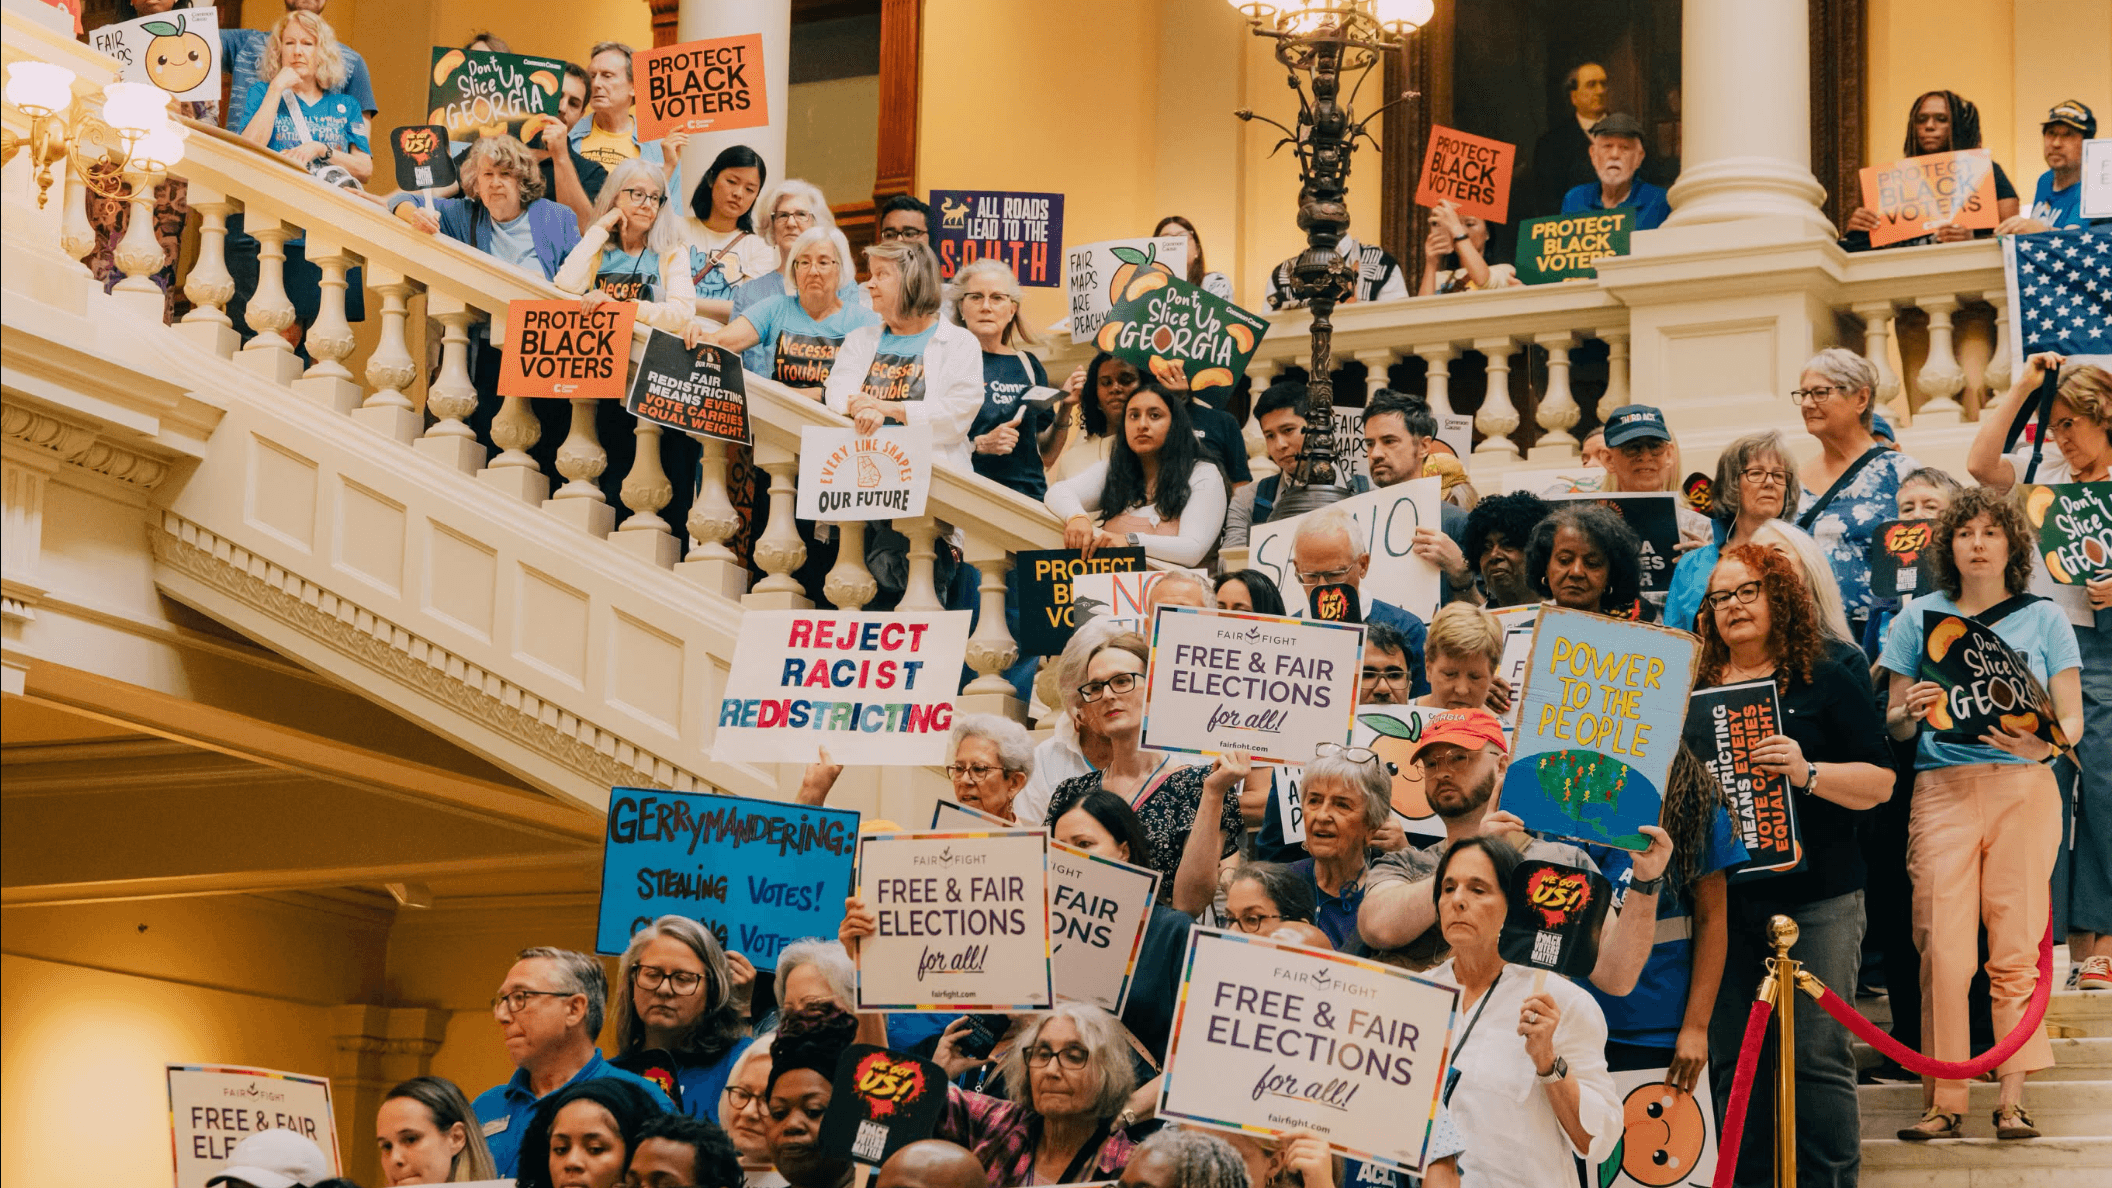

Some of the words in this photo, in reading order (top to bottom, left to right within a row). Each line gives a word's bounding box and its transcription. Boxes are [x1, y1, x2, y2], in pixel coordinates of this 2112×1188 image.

[96, 30, 125, 52] FAIR
[648, 45, 746, 77] PROTECT
[457, 75, 496, 98] Slice
[499, 64, 524, 96] Up
[649, 63, 749, 101] BLACK
[446, 84, 544, 130] GEORGIA
[651, 89, 751, 121] VOTERS
[404, 136, 433, 153] US!
[1436, 135, 1501, 165] PROTECT
[1431, 151, 1497, 188] BLACK
[1878, 159, 1973, 187] PROTECT
[1429, 172, 1495, 206] VOTERS
[1880, 174, 1979, 208] BLACK
[977, 196, 1000, 218] ALL
[1003, 197, 1049, 220] ROADS
[967, 218, 999, 240] LEAD
[1002, 219, 1020, 241] TO
[1023, 220, 1049, 242] THE
[1531, 214, 1626, 240] PROTECT
[1543, 232, 1611, 255] BLACK
[1070, 250, 1093, 273] FAIR
[1070, 270, 1098, 292] MAPS
[1073, 293, 1091, 315] ARE
[523, 310, 620, 330] PROTECT
[1148, 298, 1190, 327] Slice
[1195, 306, 1221, 342] Up
[520, 330, 617, 356] BLACK
[1119, 321, 1233, 367] GEORGIA
[520, 357, 614, 379] VOTERS
[690, 372, 721, 387] FAIR
[776, 358, 830, 383] Trouble
[647, 371, 744, 406] REDISTRICTING
[648, 383, 702, 406] MEANS
[704, 398, 742, 414] EVERY
[637, 402, 687, 426] EQUAL
[691, 418, 746, 439] WEIGHT.
[645, 393, 684, 413] VOTE
[687, 406, 743, 427] CARRIES
[1620, 413, 1642, 425] THIRD
[820, 445, 849, 484] EVERY
[855, 438, 878, 453] LINE
[882, 440, 912, 482] SHAPES
[819, 490, 852, 513] OUR
[856, 489, 910, 511] FUTURE
[1890, 534, 1926, 551] US!
[2055, 514, 2103, 541] Slice
[1321, 601, 1342, 619] US!
[788, 619, 929, 652] REJECT
[1217, 630, 1244, 641] FAIR
[1262, 634, 1297, 646] FIGHT
[780, 658, 924, 690] RACIST
[1175, 643, 1242, 671] FREE
[1248, 652, 1266, 674] &
[1275, 654, 1334, 681] FAIR
[1550, 636, 1666, 689] POWER
[1964, 648, 2012, 677] Slice
[1171, 669, 1332, 708] ELECTIONS
[1559, 677, 1592, 710] TO
[1599, 684, 1643, 720] THE
[718, 698, 953, 733] REDISTRICTING
[1207, 703, 1241, 733] for
[1244, 709, 1289, 731] all!
[1538, 702, 1653, 758] PEOPLE
[1728, 709, 1749, 774] EVERY
[1743, 704, 1767, 791] CARIES
[1736, 778, 1759, 849] MEANS
[1755, 795, 1774, 849] VOTE
[1769, 785, 1789, 852] EQUAL
[913, 855, 938, 866] FAIR
[954, 854, 987, 866] FIGHT
[1052, 861, 1084, 879] IGHT
[748, 876, 825, 912] VOTES!
[878, 878, 939, 903] FREE
[946, 877, 963, 903] &
[970, 876, 1024, 902] FAIR
[1541, 875, 1557, 884] WE
[1558, 878, 1581, 889] GOT
[1053, 884, 1120, 923] FAIR
[1532, 884, 1580, 912] US!
[878, 908, 1026, 937] ELECTIONS
[916, 946, 947, 982] for
[950, 944, 989, 971] all!
[931, 989, 977, 1000] fairfight.com
[1273, 967, 1308, 984] FAIR
[1333, 980, 1378, 1000] FIGHT
[1213, 981, 1305, 1023] FREE
[1313, 1002, 1336, 1031] &
[1347, 1008, 1420, 1053] FAIR
[1206, 1014, 1414, 1086] ELECTIONS
[860, 1070, 914, 1102] US!
[889, 1064, 914, 1078] GOT
[1251, 1064, 1299, 1102] for
[1303, 1077, 1360, 1108] all!
[223, 1088, 246, 1098] FAIR
[260, 1091, 285, 1102] FIGHT
[191, 1106, 250, 1132] FREE
[256, 1110, 269, 1132] &
[1268, 1113, 1331, 1134] fairfight.com
